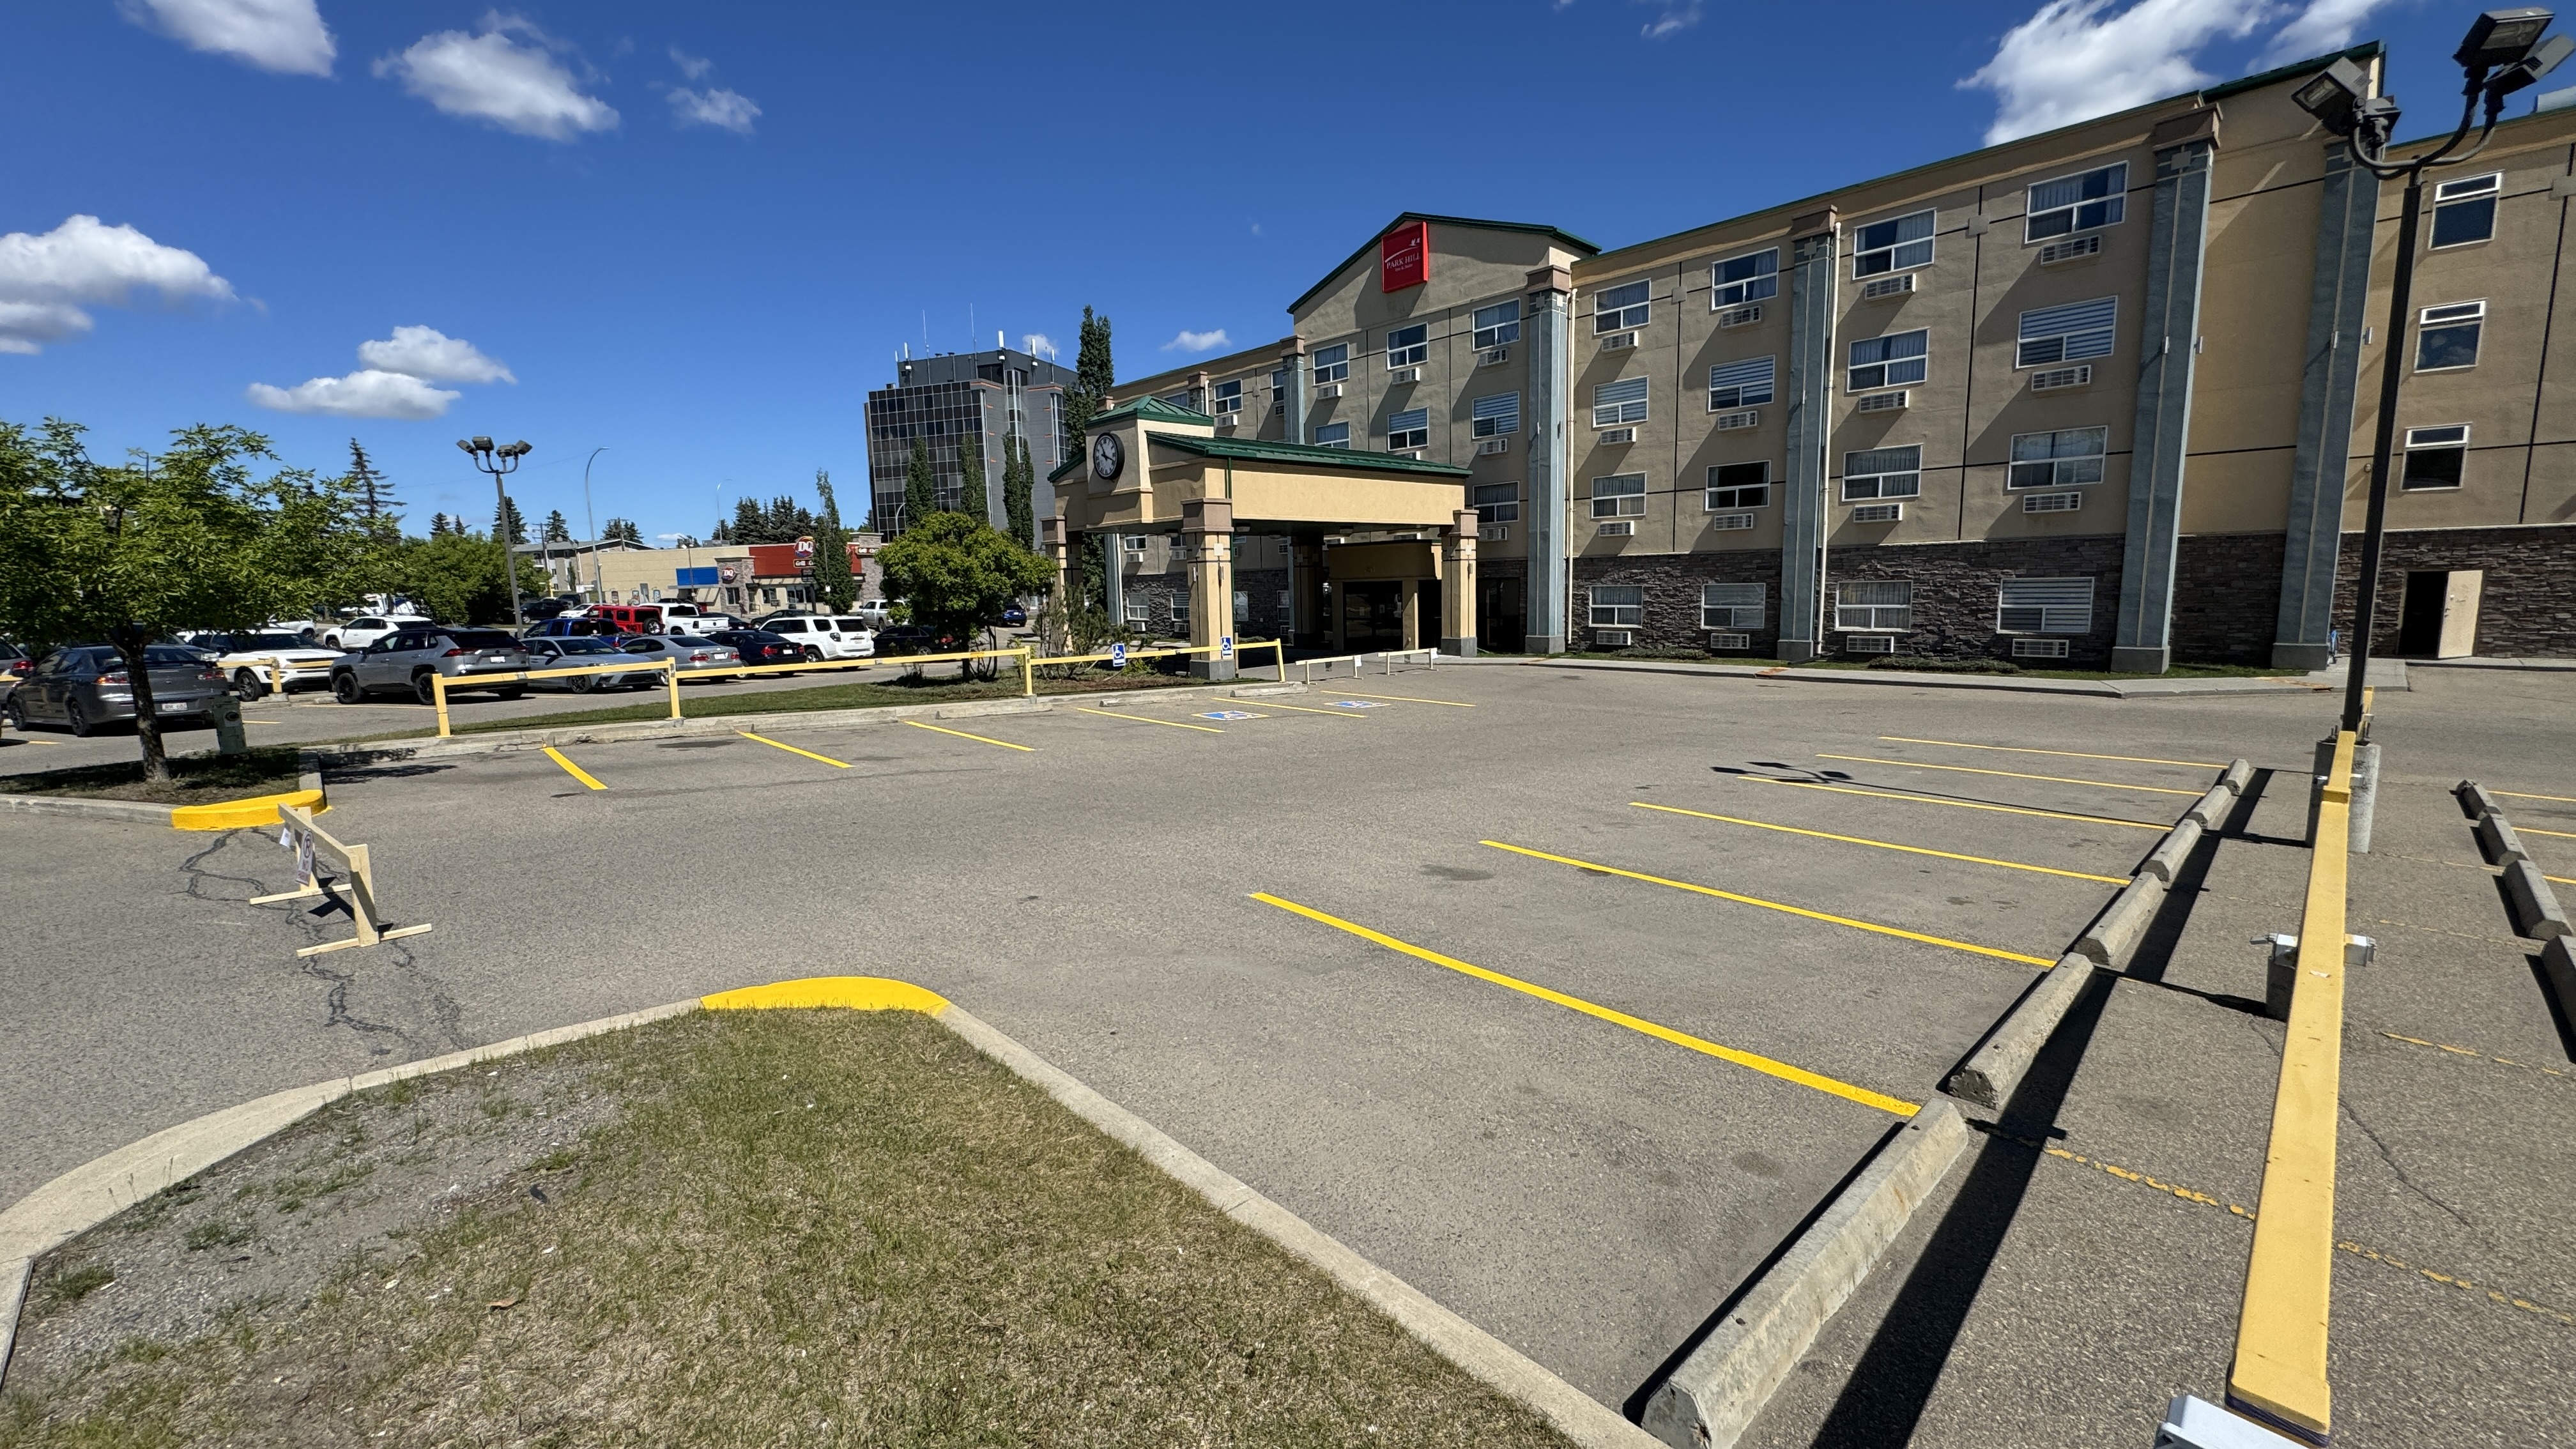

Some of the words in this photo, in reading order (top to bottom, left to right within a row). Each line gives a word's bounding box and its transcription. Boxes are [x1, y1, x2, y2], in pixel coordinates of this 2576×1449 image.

[1386, 257, 1404, 269] PARK
[1405, 252, 1421, 264] HILL
[799, 541, 814, 553] DQ
